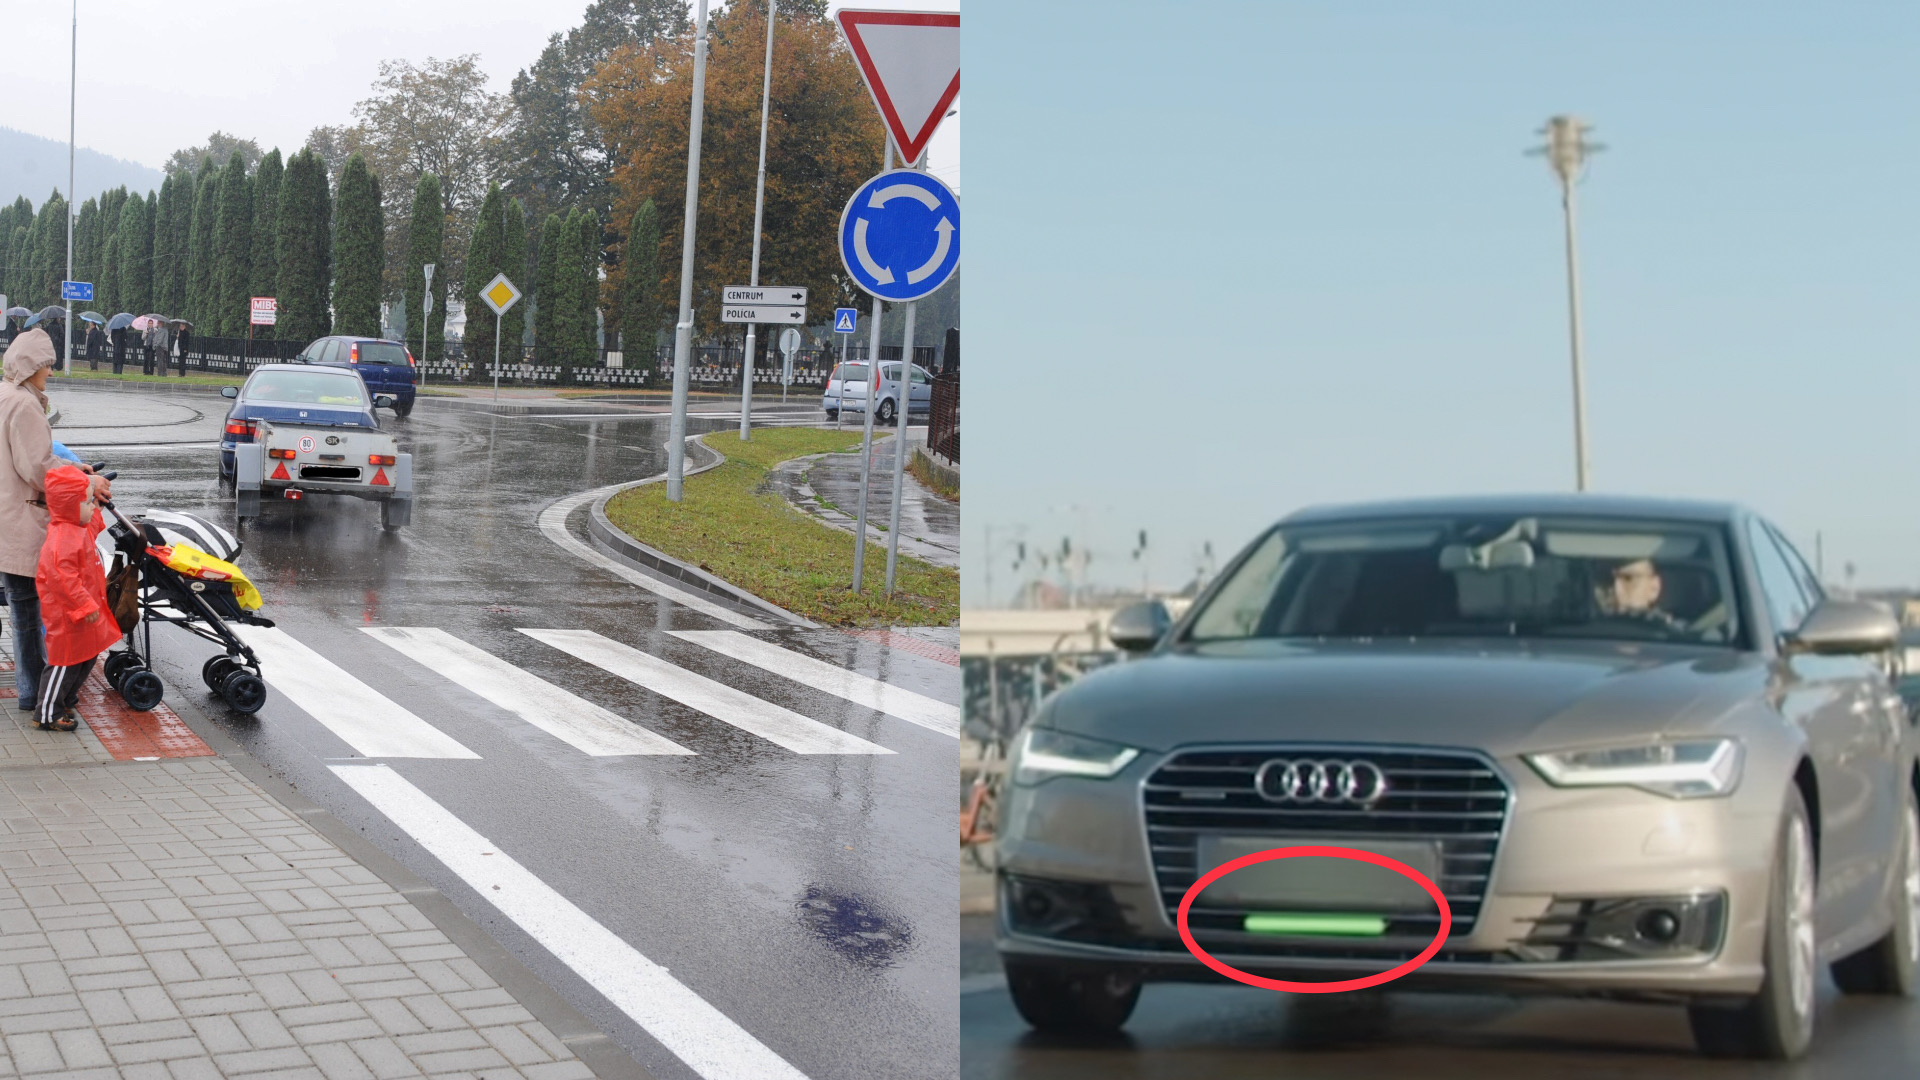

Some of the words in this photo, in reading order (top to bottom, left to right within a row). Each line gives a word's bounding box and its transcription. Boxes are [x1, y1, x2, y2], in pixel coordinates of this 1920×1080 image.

[727, 291, 763, 300] CENTRUM
[726, 309, 756, 319] POLÍCIA
[302, 439, 312, 448] 80
[326, 437, 338, 445] SK
